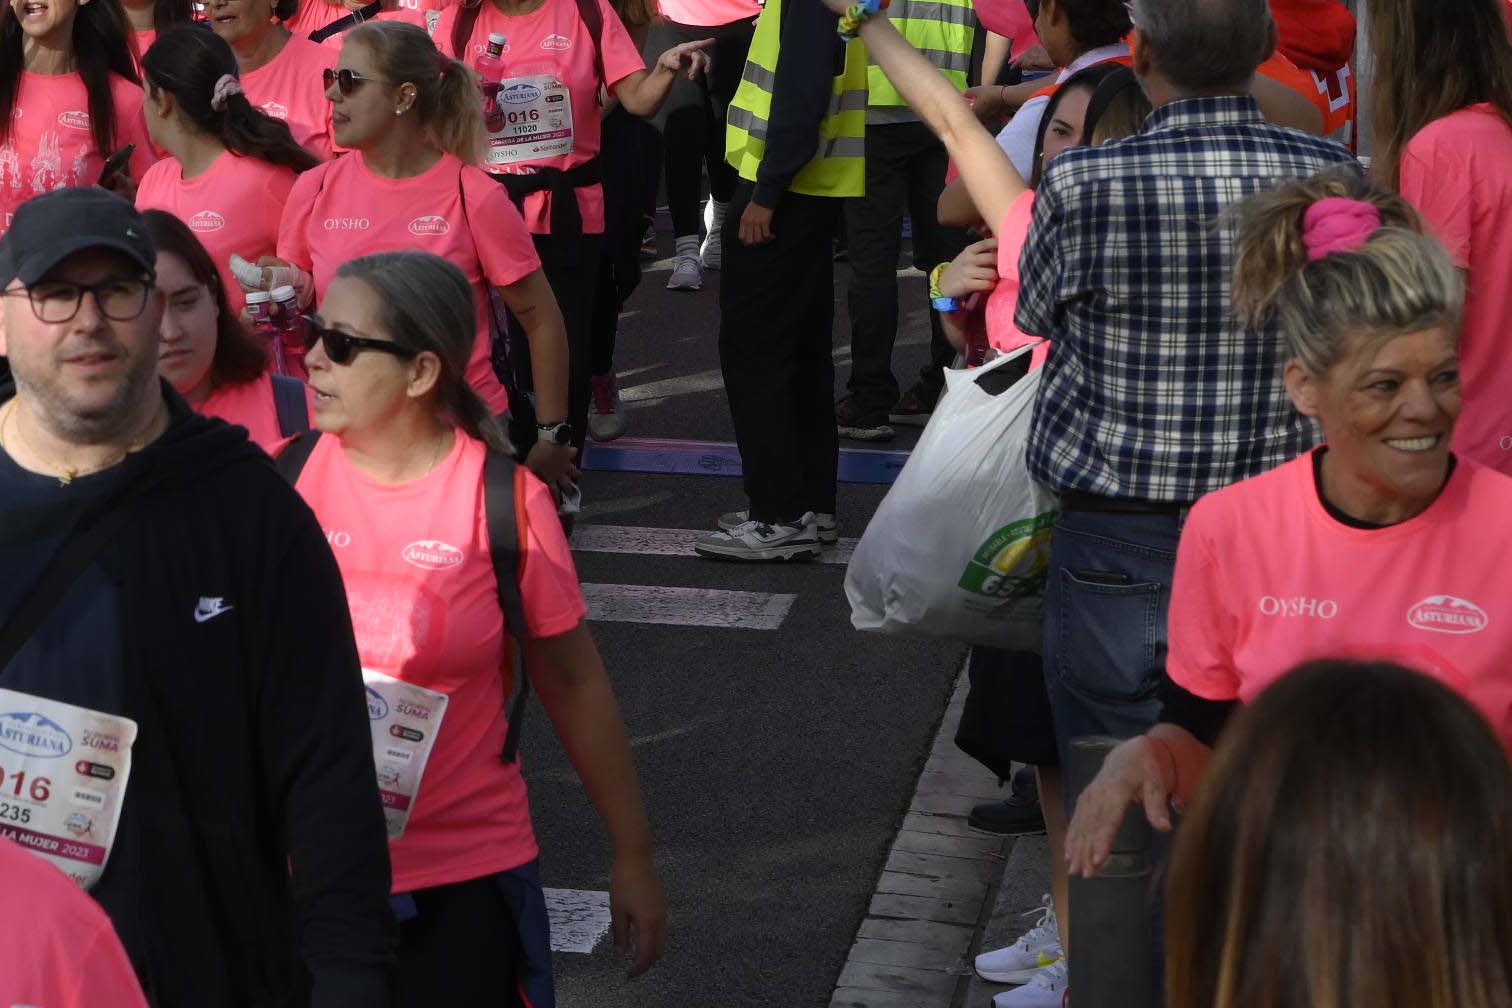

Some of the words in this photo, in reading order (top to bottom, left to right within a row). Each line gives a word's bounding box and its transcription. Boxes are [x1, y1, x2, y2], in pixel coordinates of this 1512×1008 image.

[508, 109, 539, 123] 016
[513, 124, 538, 135] 11020
[324, 217, 370, 231] OYSHO
[1259, 595, 1337, 620] OYSHO
[19, 832, 59, 851] MUJER
[61, 842, 89, 858] 2023
